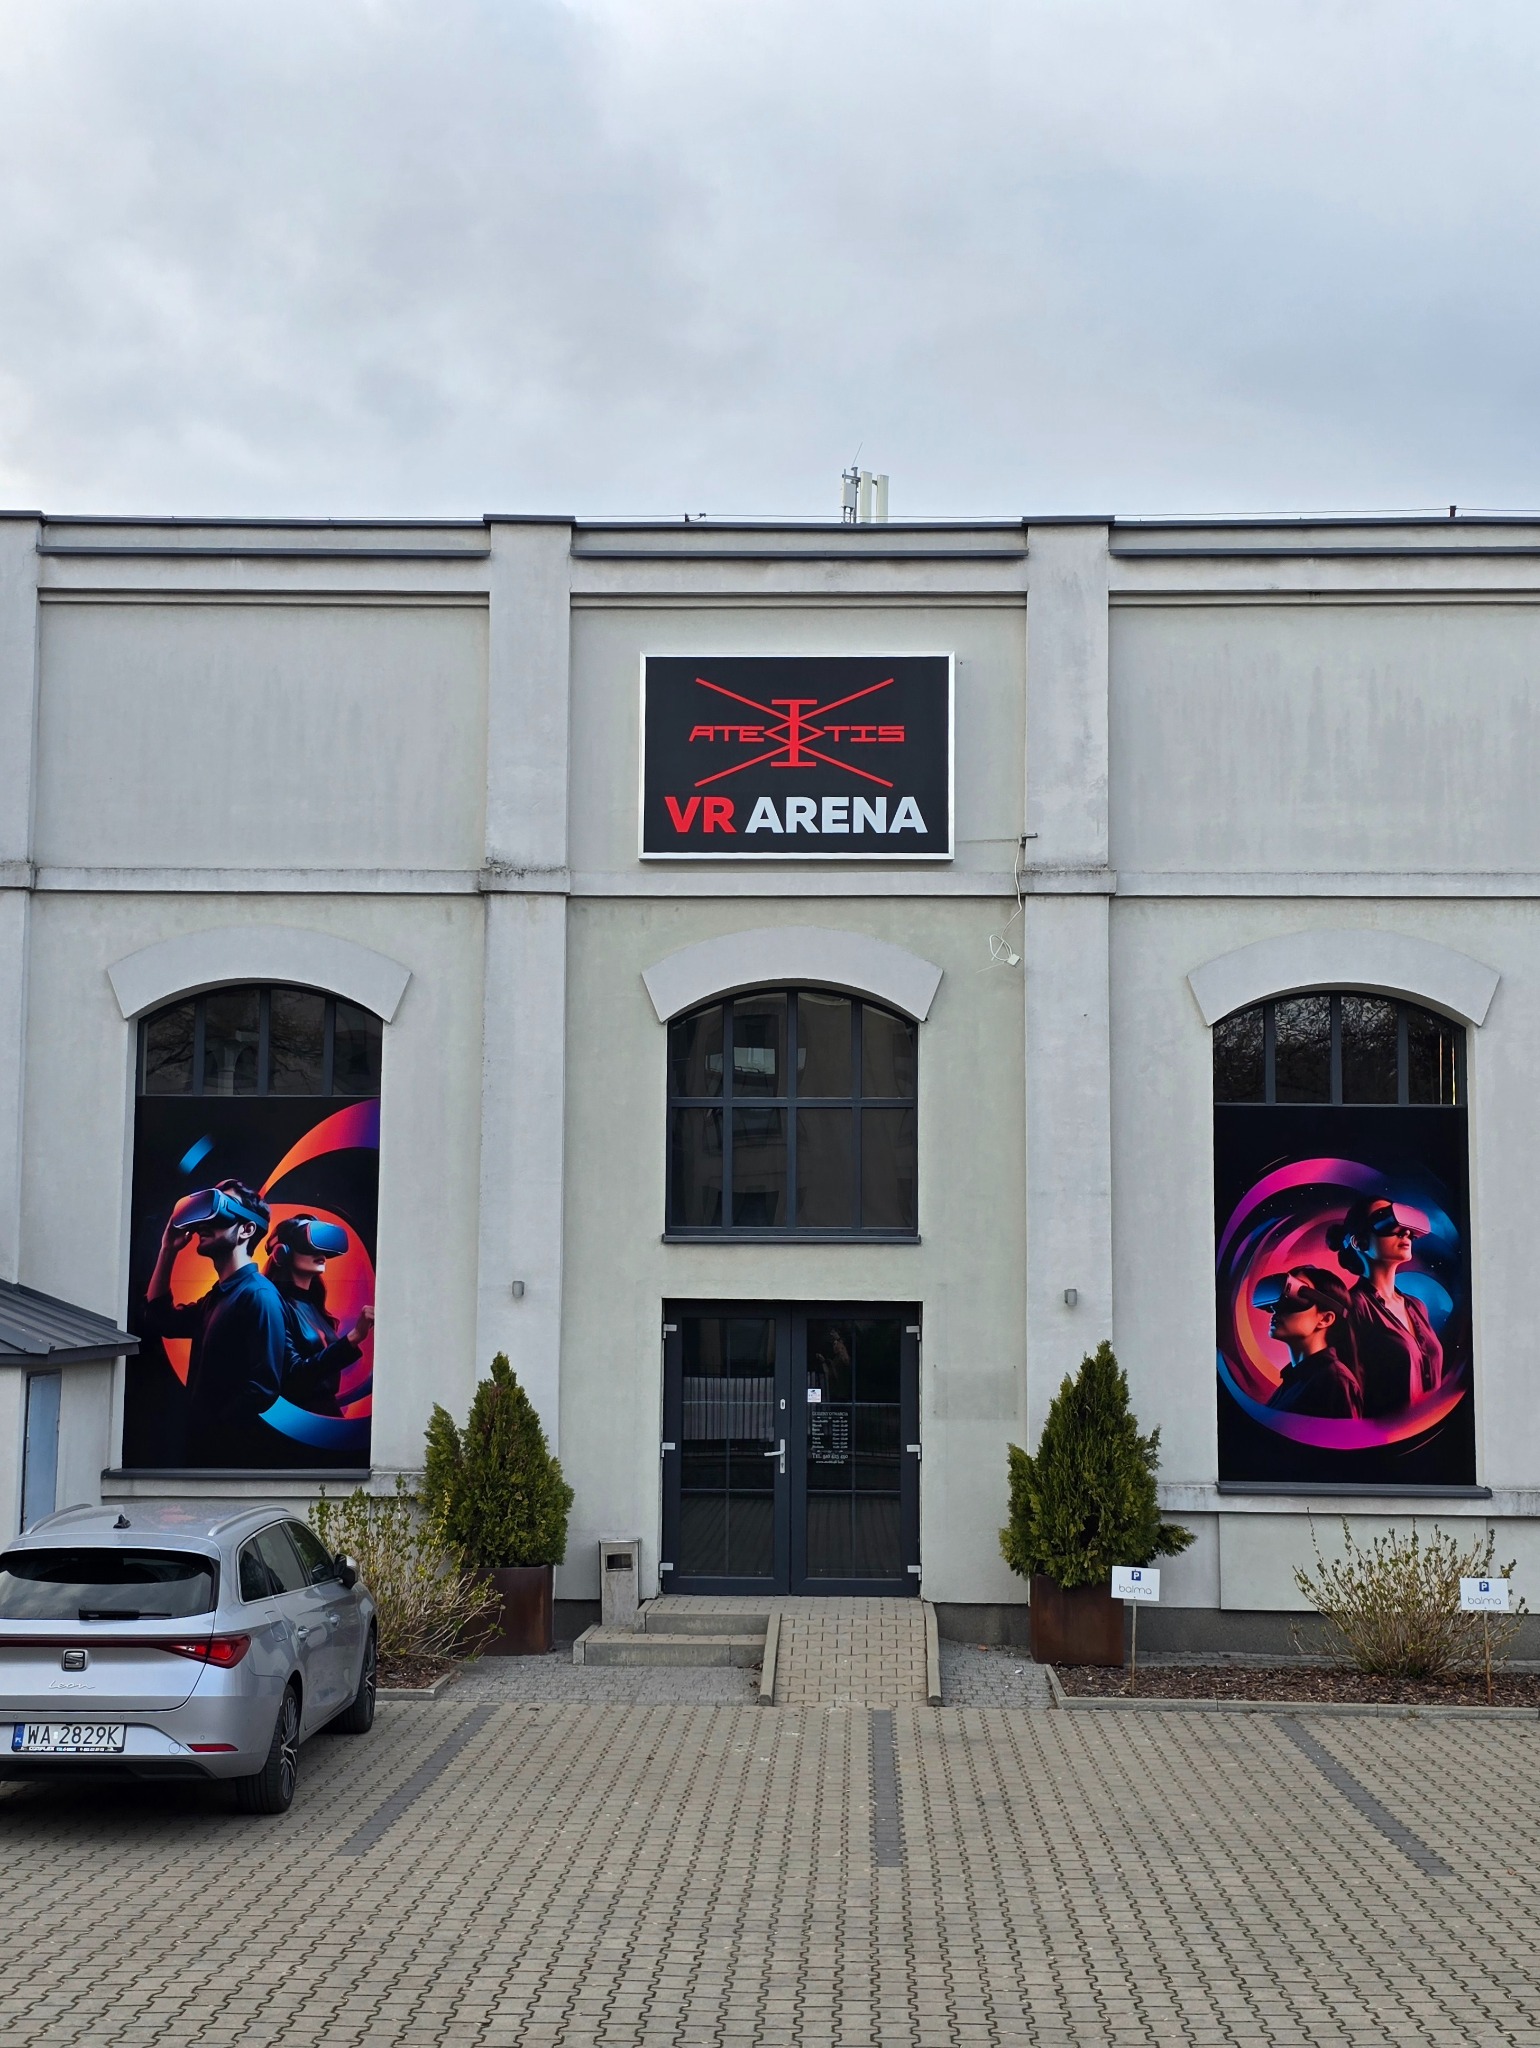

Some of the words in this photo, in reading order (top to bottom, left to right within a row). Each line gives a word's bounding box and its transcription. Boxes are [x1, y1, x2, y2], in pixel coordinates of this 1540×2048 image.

[664, 796, 737, 833] VR
[744, 796, 928, 834] ARENA
[49, 1680, 95, 1689] Leon
[28, 1725, 51, 1745] WA
[59, 1726, 119, 1745] 2829K
